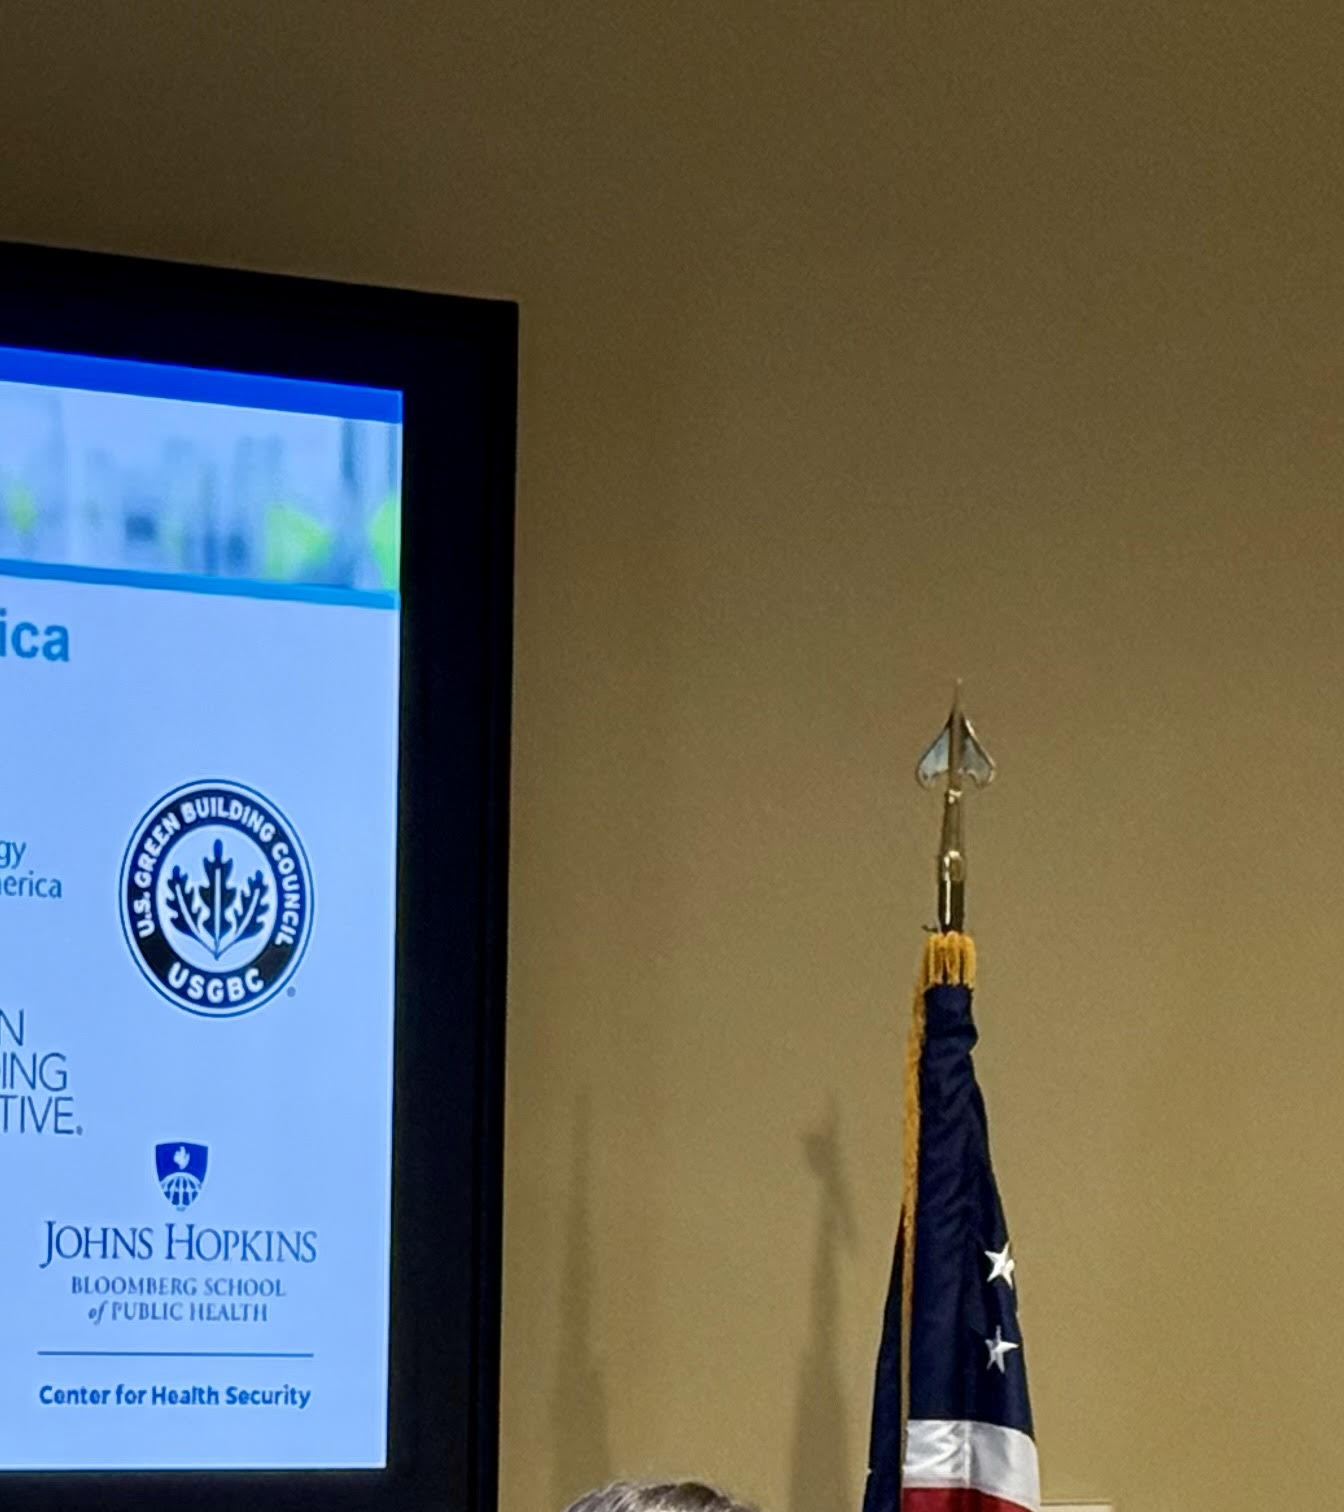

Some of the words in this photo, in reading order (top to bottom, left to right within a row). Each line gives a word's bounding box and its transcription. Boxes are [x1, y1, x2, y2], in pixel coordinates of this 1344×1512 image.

[179, 796, 277, 843] BUILDING
[133, 812, 182, 889] GREEN
[133, 891, 156, 939] U.S.
[271, 842, 301, 946] COUNCIL
[167, 961, 265, 1004] USGBC
[39, 1220, 155, 1269] JOHNS
[164, 1222, 318, 1264] HOPKINS
[71, 1275, 198, 1297] BLOOMBERG
[203, 1277, 287, 1297] SCHOOL
[88, 1301, 108, 1326] of
[111, 1302, 184, 1322] PUBLIC
[189, 1303, 269, 1323] HEALTH
[39, 1385, 111, 1406] Center
[115, 1384, 147, 1406] for
[151, 1386, 220, 1406] Health
[225, 1384, 311, 1409] Security
